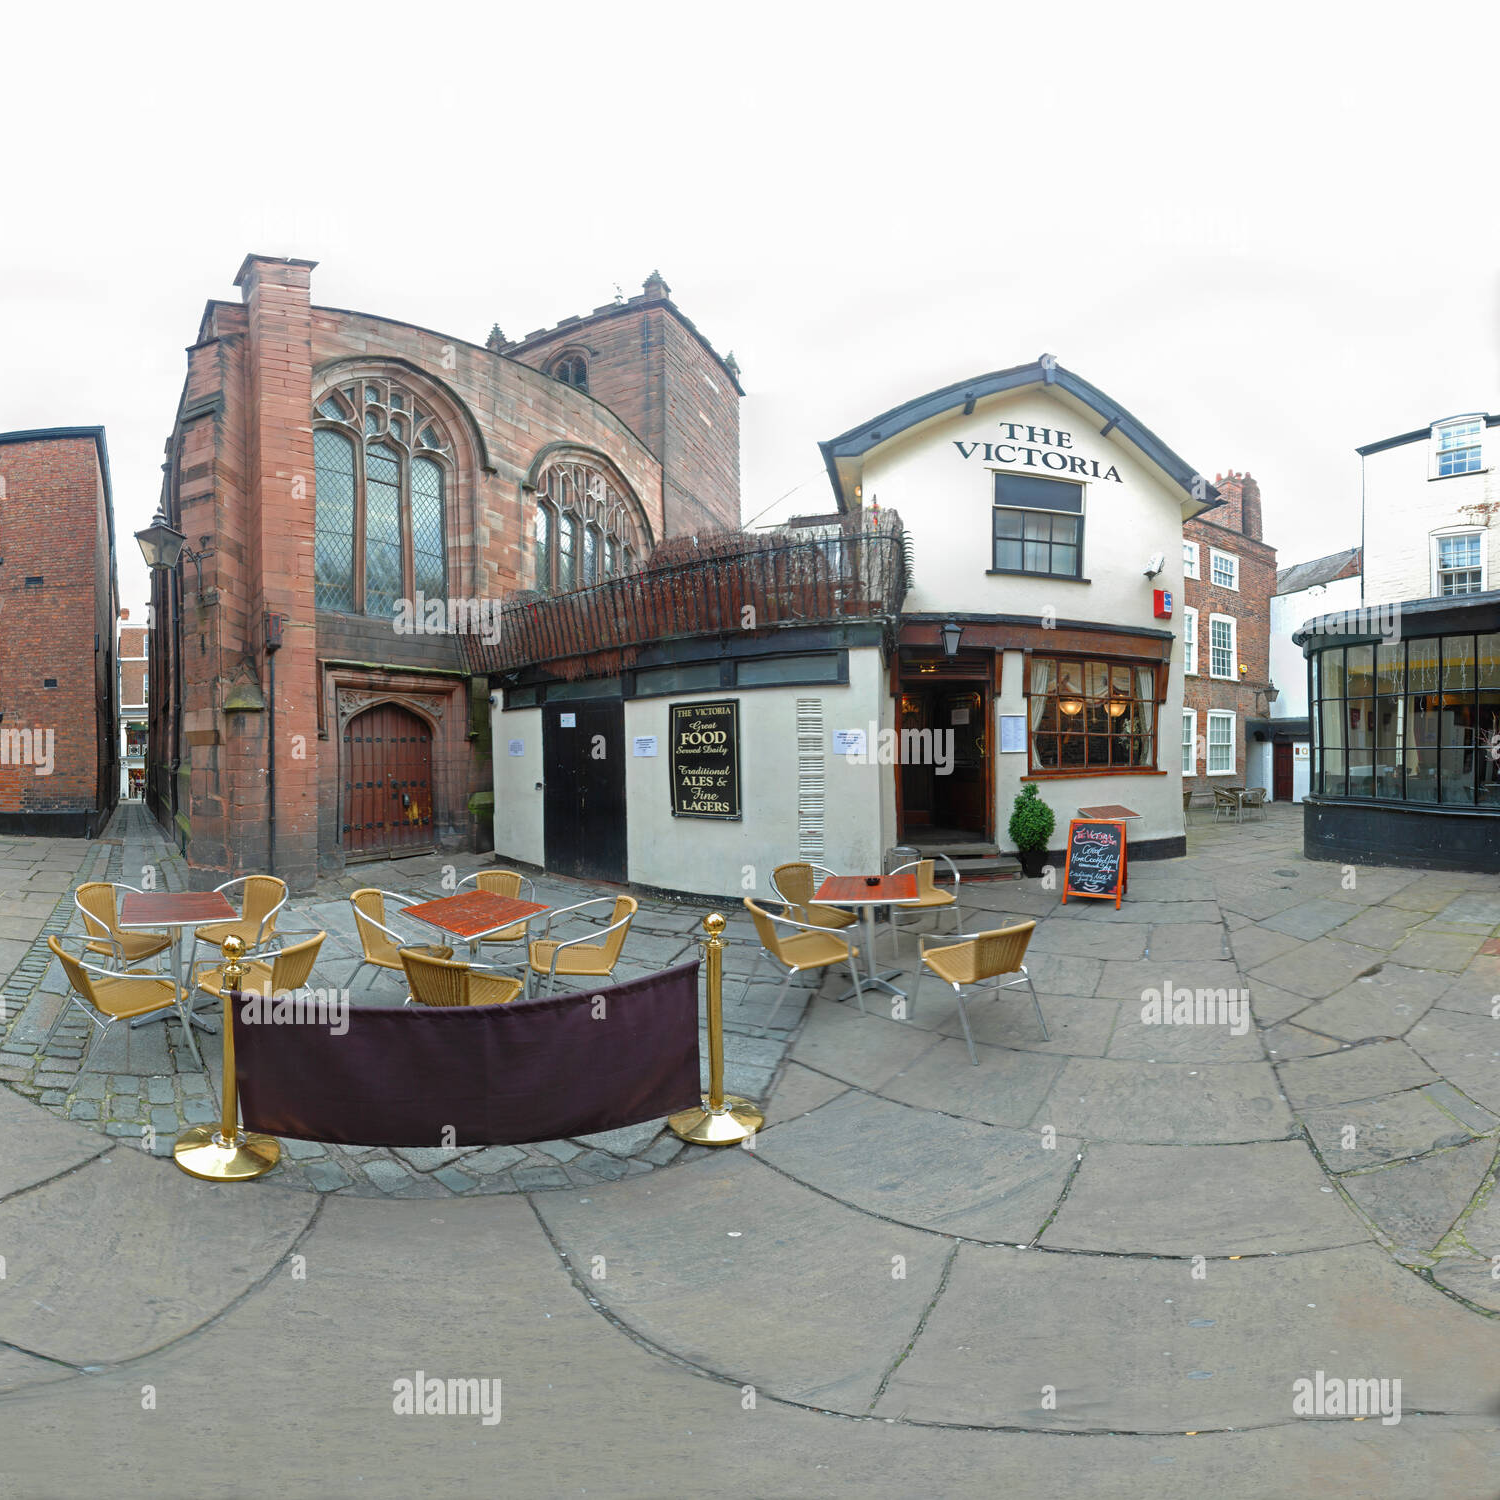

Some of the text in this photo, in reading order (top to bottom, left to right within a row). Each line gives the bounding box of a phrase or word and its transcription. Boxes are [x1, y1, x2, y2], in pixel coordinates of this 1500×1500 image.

[999, 422, 1073, 449] THE
[953, 441, 1124, 484] VICTORIA
[677, 707, 732, 718] THE VICTORIA
[689, 720, 717, 732] Great
[681, 731, 727, 745] FOOD
[676, 744, 729, 756] Served Daily
[678, 765, 731, 776] Traditional
[682, 776, 728, 787] ALES &
[691, 787, 719, 801] Fine
[682, 800, 730, 812] LAGERS
